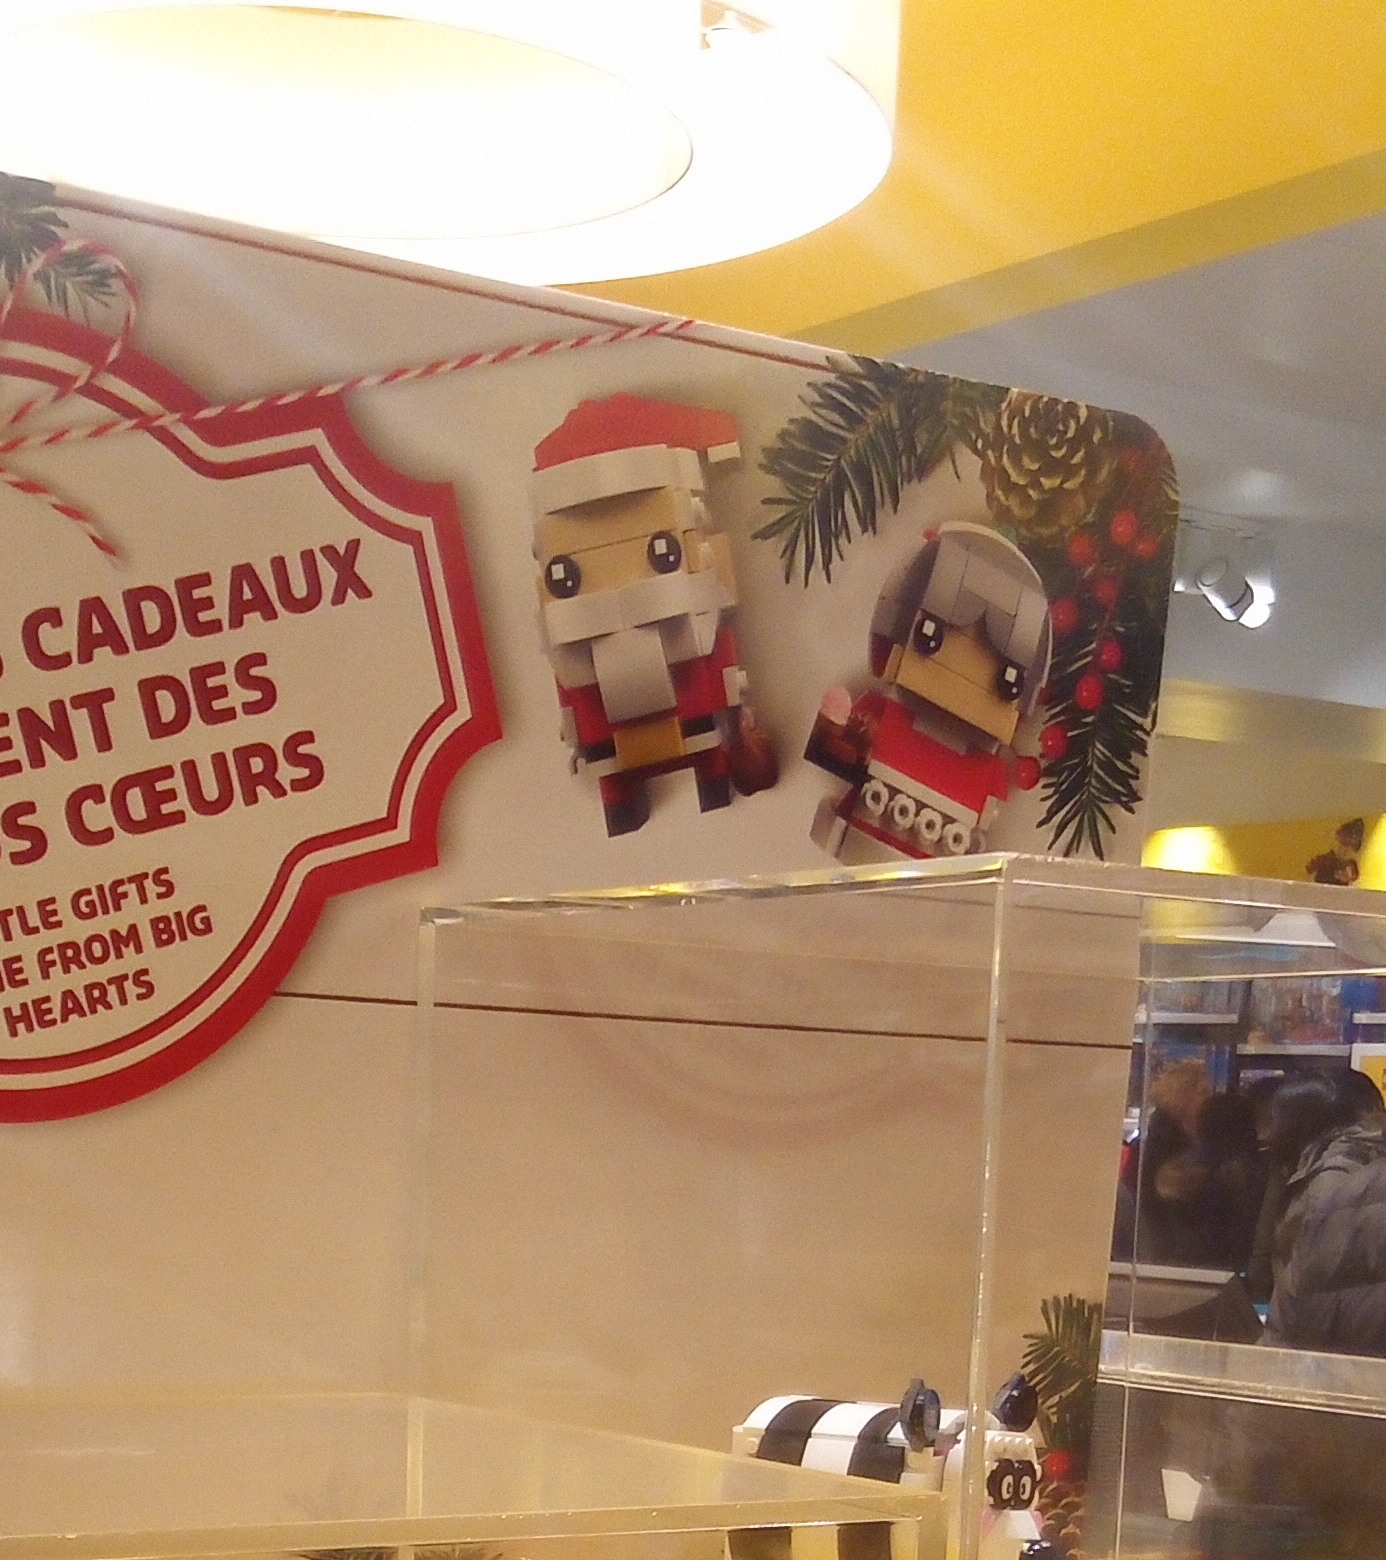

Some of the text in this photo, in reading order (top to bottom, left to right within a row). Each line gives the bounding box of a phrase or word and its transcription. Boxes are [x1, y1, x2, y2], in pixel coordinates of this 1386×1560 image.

[20, 537, 373, 670] CADEAUX
[136, 651, 279, 741] DES
[64, 729, 326, 847] CŒURS
[70, 866, 176, 924] GIFTS
[38, 927, 145, 983] FROM
[151, 903, 214, 948] BIG
[3, 967, 156, 1038] HEARTS
